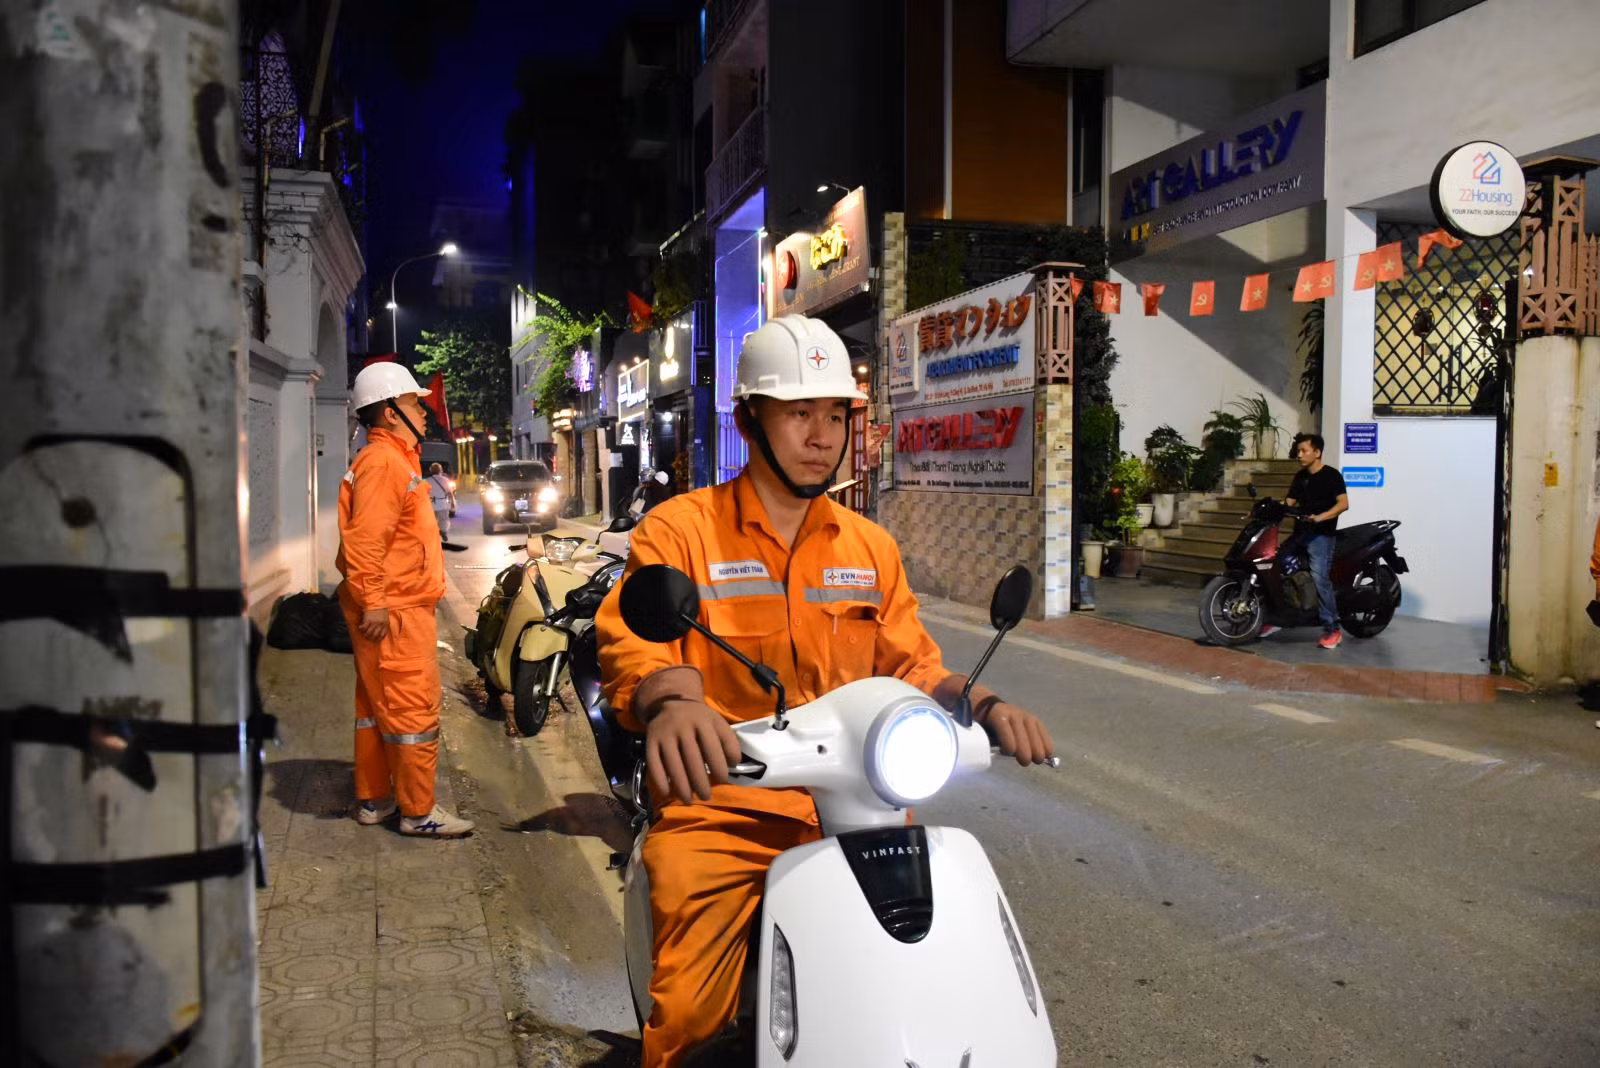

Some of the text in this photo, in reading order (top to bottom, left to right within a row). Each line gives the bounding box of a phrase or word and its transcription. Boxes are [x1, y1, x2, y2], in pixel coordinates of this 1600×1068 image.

[1163, 110, 1303, 203] GALLERY
[1262, 174, 1301, 198] COMPANY
[1460, 188, 1513, 206] 22Housing
[862, 846, 921, 860] VINFAST
